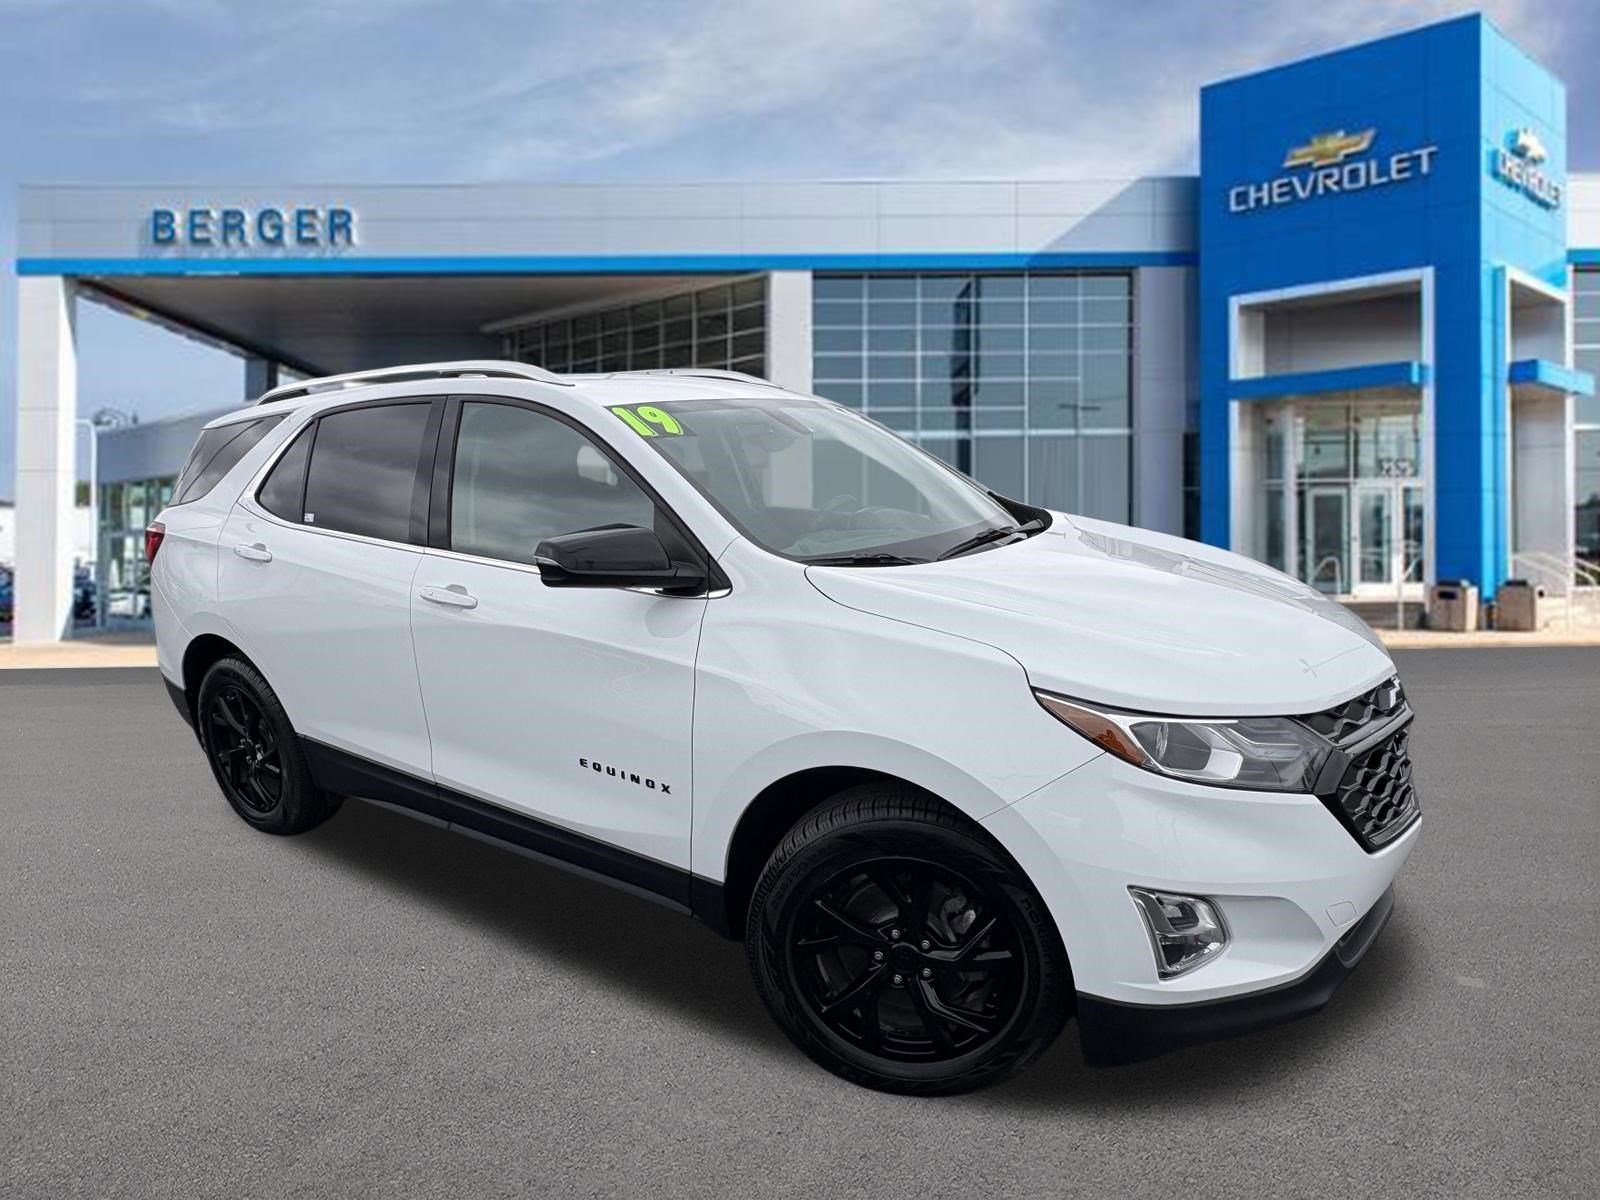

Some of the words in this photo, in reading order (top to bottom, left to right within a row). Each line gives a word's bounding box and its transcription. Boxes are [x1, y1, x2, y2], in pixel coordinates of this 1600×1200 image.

[1229, 147, 1438, 212] CHEVROLET
[152, 208, 354, 246] BERGER
[611, 406, 684, 437] 19
[579, 758, 671, 795] EQUINOX
